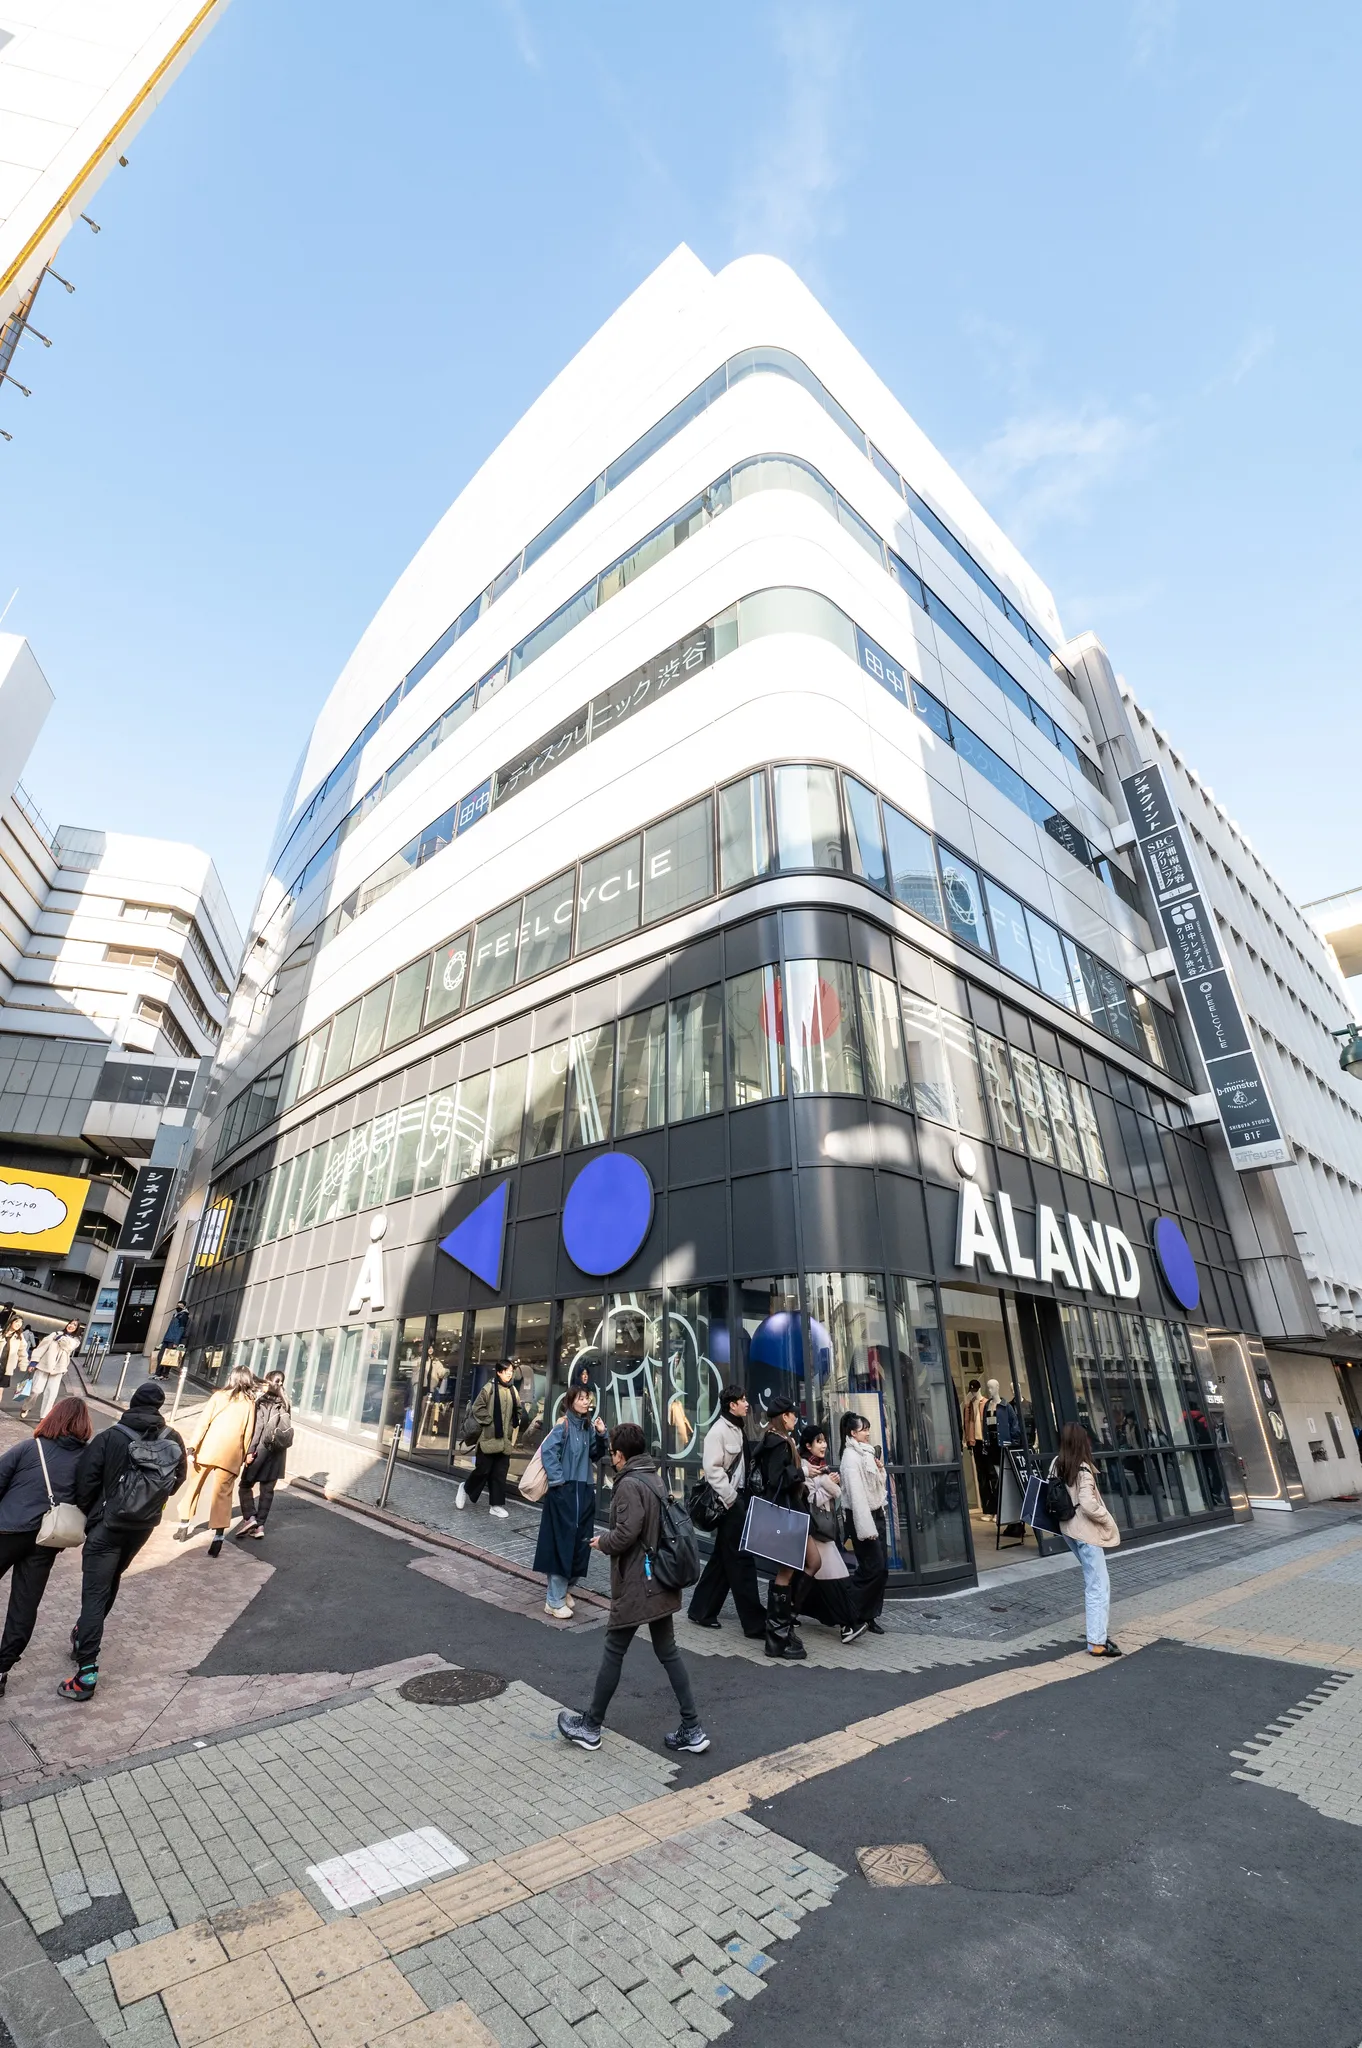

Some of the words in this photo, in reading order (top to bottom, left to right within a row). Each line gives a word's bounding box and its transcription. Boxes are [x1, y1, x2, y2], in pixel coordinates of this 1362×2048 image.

[1134, 775, 1161, 831] シネクイント
[1147, 835, 1174, 853] SBC
[476, 849, 672, 967] FEELCYCLE
[1184, 922, 1207, 973] 田中レディス
[1204, 993, 1228, 1049] FEELCYCLE
[1216, 1080, 1258, 1097] b-monster
[1244, 1130, 1262, 1141] B1F
[1251, 1117, 1271, 1127] STUDIO
[130, 1171, 164, 1245] シネクイント
